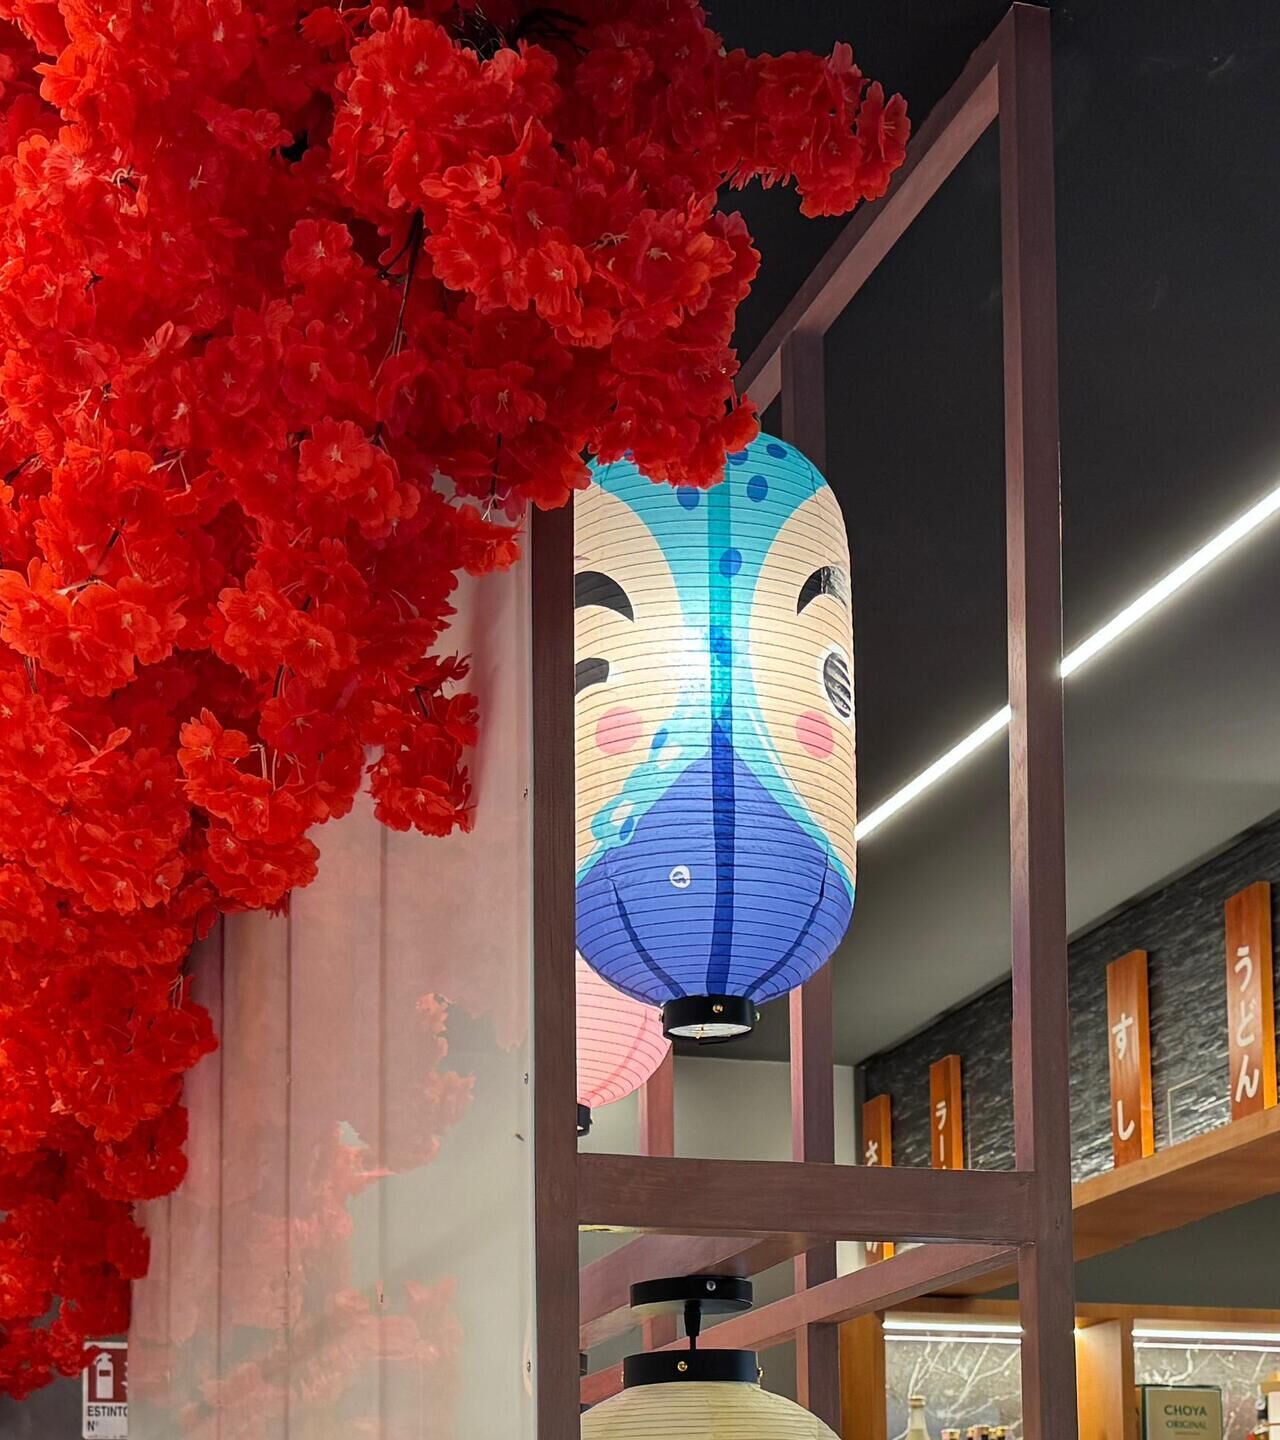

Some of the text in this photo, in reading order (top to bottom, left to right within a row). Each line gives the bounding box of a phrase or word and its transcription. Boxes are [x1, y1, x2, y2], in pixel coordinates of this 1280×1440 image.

[1112, 1013, 1135, 1142] すし
[1233, 945, 1260, 1103] うどん
[1164, 1404, 1208, 1416] CHOYA
